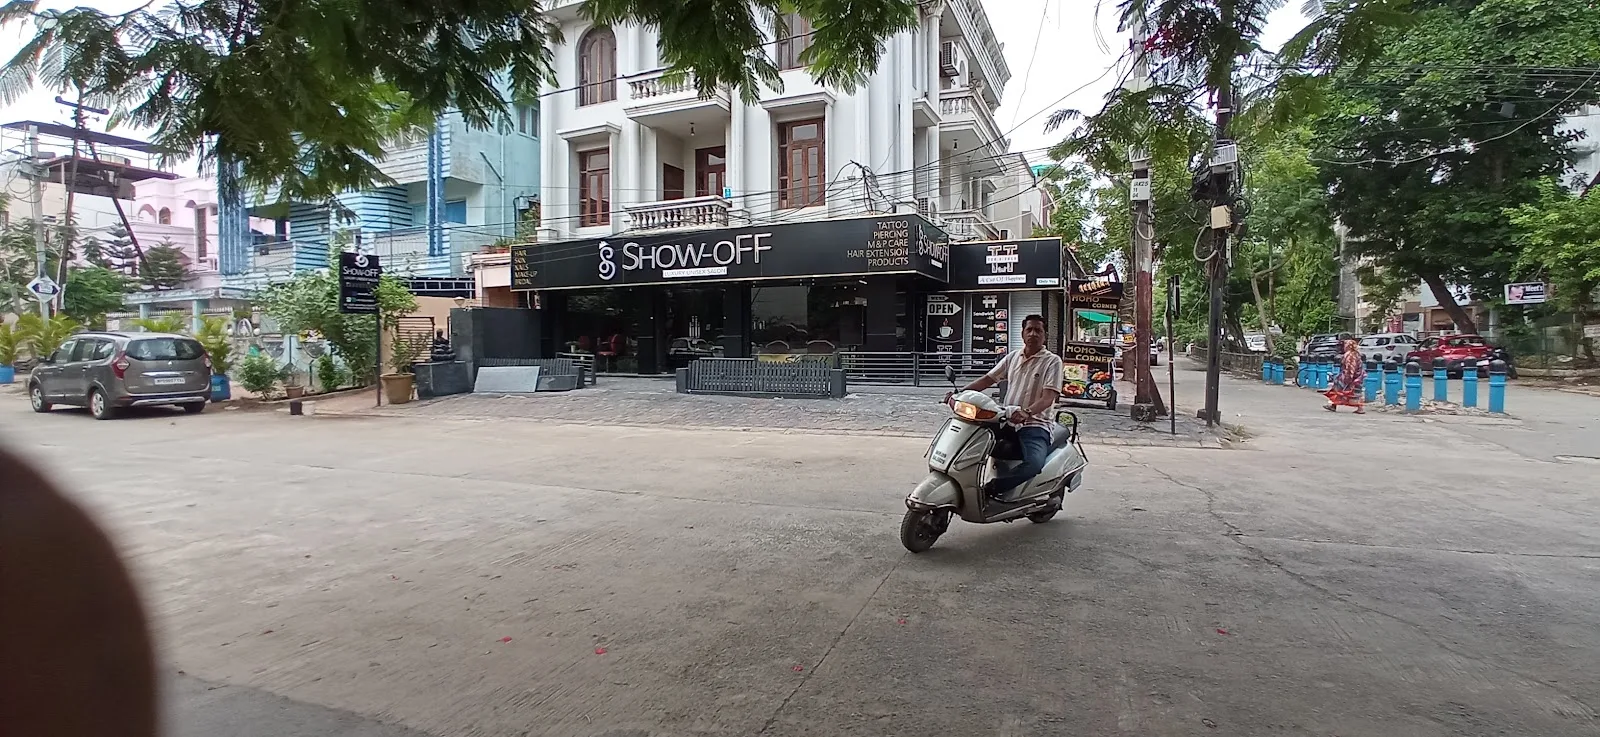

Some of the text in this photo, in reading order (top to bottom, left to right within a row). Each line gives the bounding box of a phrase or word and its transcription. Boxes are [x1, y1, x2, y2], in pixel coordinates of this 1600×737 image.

[877, 220, 909, 229] TATTOO
[874, 230, 908, 240] PIERCING
[888, 238, 909, 248] CARE
[622, 232, 773, 271] SHOW-OFF
[847, 247, 909, 258] HAIR EXTENSION
[868, 257, 909, 267] PRODUCTS
[929, 303, 954, 314] OPEN
[1066, 346, 1096, 354] MOMO
[1076, 354, 1112, 362] CORNER
